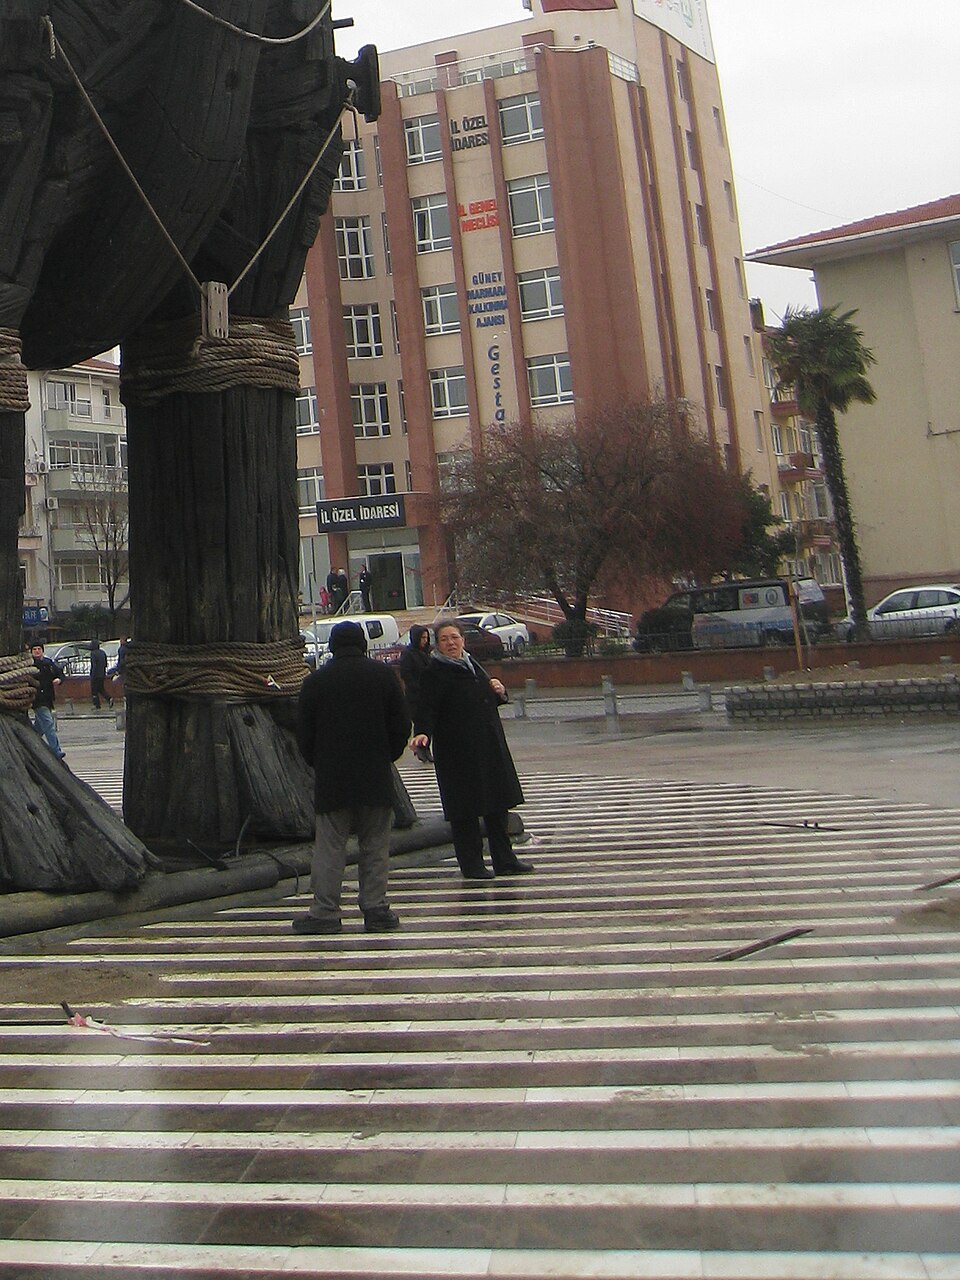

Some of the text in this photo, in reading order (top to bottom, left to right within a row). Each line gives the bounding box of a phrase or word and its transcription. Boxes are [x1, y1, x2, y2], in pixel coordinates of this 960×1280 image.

[450, 116, 488, 135] İL ÖZEL
[469, 199, 498, 214] GENEL
[472, 272, 502, 285] GÜNEY
[476, 315, 505, 328] AJANSI
[321, 502, 400, 524] İL ÖZEL İDARESİ
